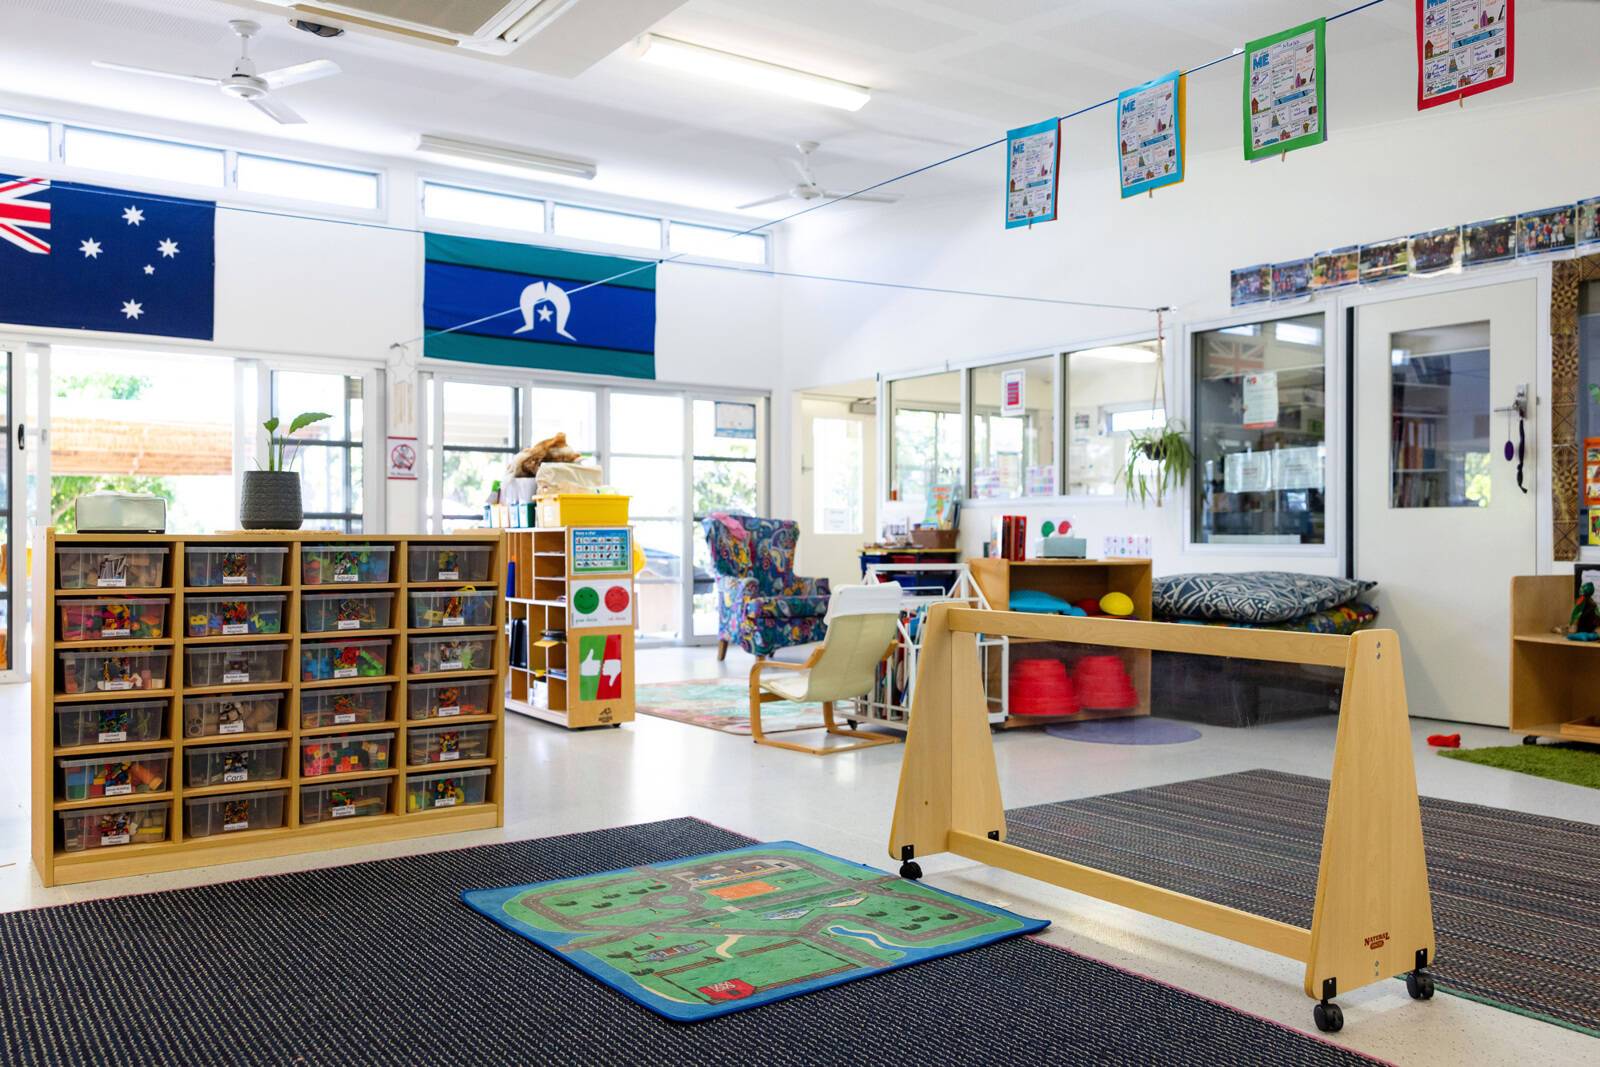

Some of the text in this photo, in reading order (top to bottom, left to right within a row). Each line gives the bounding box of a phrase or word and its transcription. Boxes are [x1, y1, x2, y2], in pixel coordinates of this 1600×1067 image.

[1252, 53, 1270, 70] ME
[1122, 100, 1136, 115] ME
[1012, 143, 1025, 155] ME
